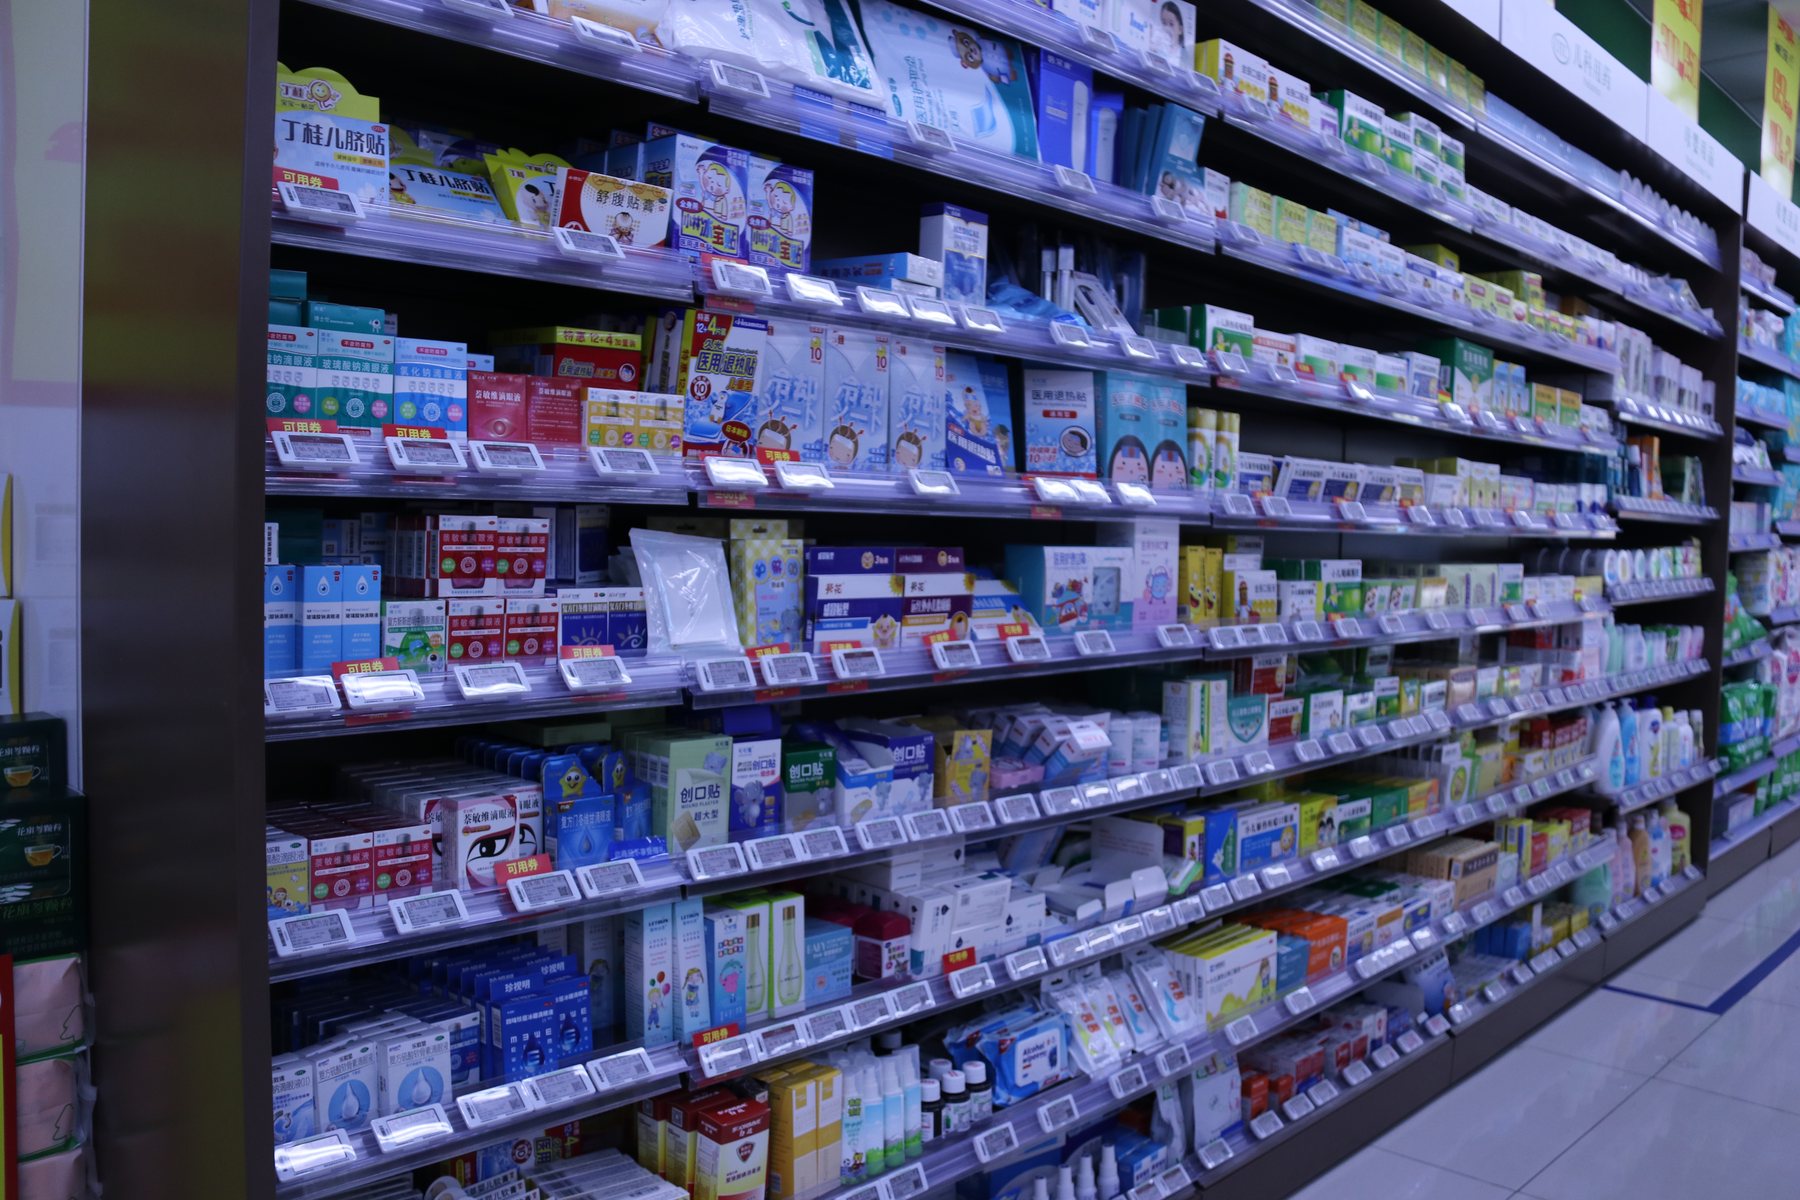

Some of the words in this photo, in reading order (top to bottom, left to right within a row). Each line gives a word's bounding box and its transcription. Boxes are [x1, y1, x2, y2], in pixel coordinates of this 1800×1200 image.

[281, 119, 385, 155] 丁桂儿脐贴
[283, 170, 323, 188] 可用券
[400, 168, 490, 194] 丁桂儿脐贴
[596, 189, 653, 213] 舒腹贴膏
[811, 347, 822, 360] 10
[322, 359, 389, 374] 玻璃酸钠滴眼液
[697, 352, 757, 376] 医用退热贴
[876, 356, 887, 368] 10
[935, 367, 944, 378] 10
[475, 389, 521, 402] 萘敏维滴眼液
[1031, 389, 1087, 402] 医用退热贴
[282, 421, 322, 433] 可用券
[396, 427, 432, 438] 可用券
[765, 450, 790, 461] 可用券
[572, 648, 602, 657] 可用券
[346, 661, 384, 672] 可用券
[893, 744, 926, 762] 创口贴
[752, 759, 776, 770] 创口贴
[789, 763, 824, 779] 创口贴
[681, 783, 720, 803] 创口贴
[464, 808, 515, 825] 萘敏维滴眼液
[507, 859, 538, 875] 可用券
[541, 962, 565, 975] 珍视明
[505, 979, 530, 992] 珍视明
[703, 1028, 729, 1044] 可用券
